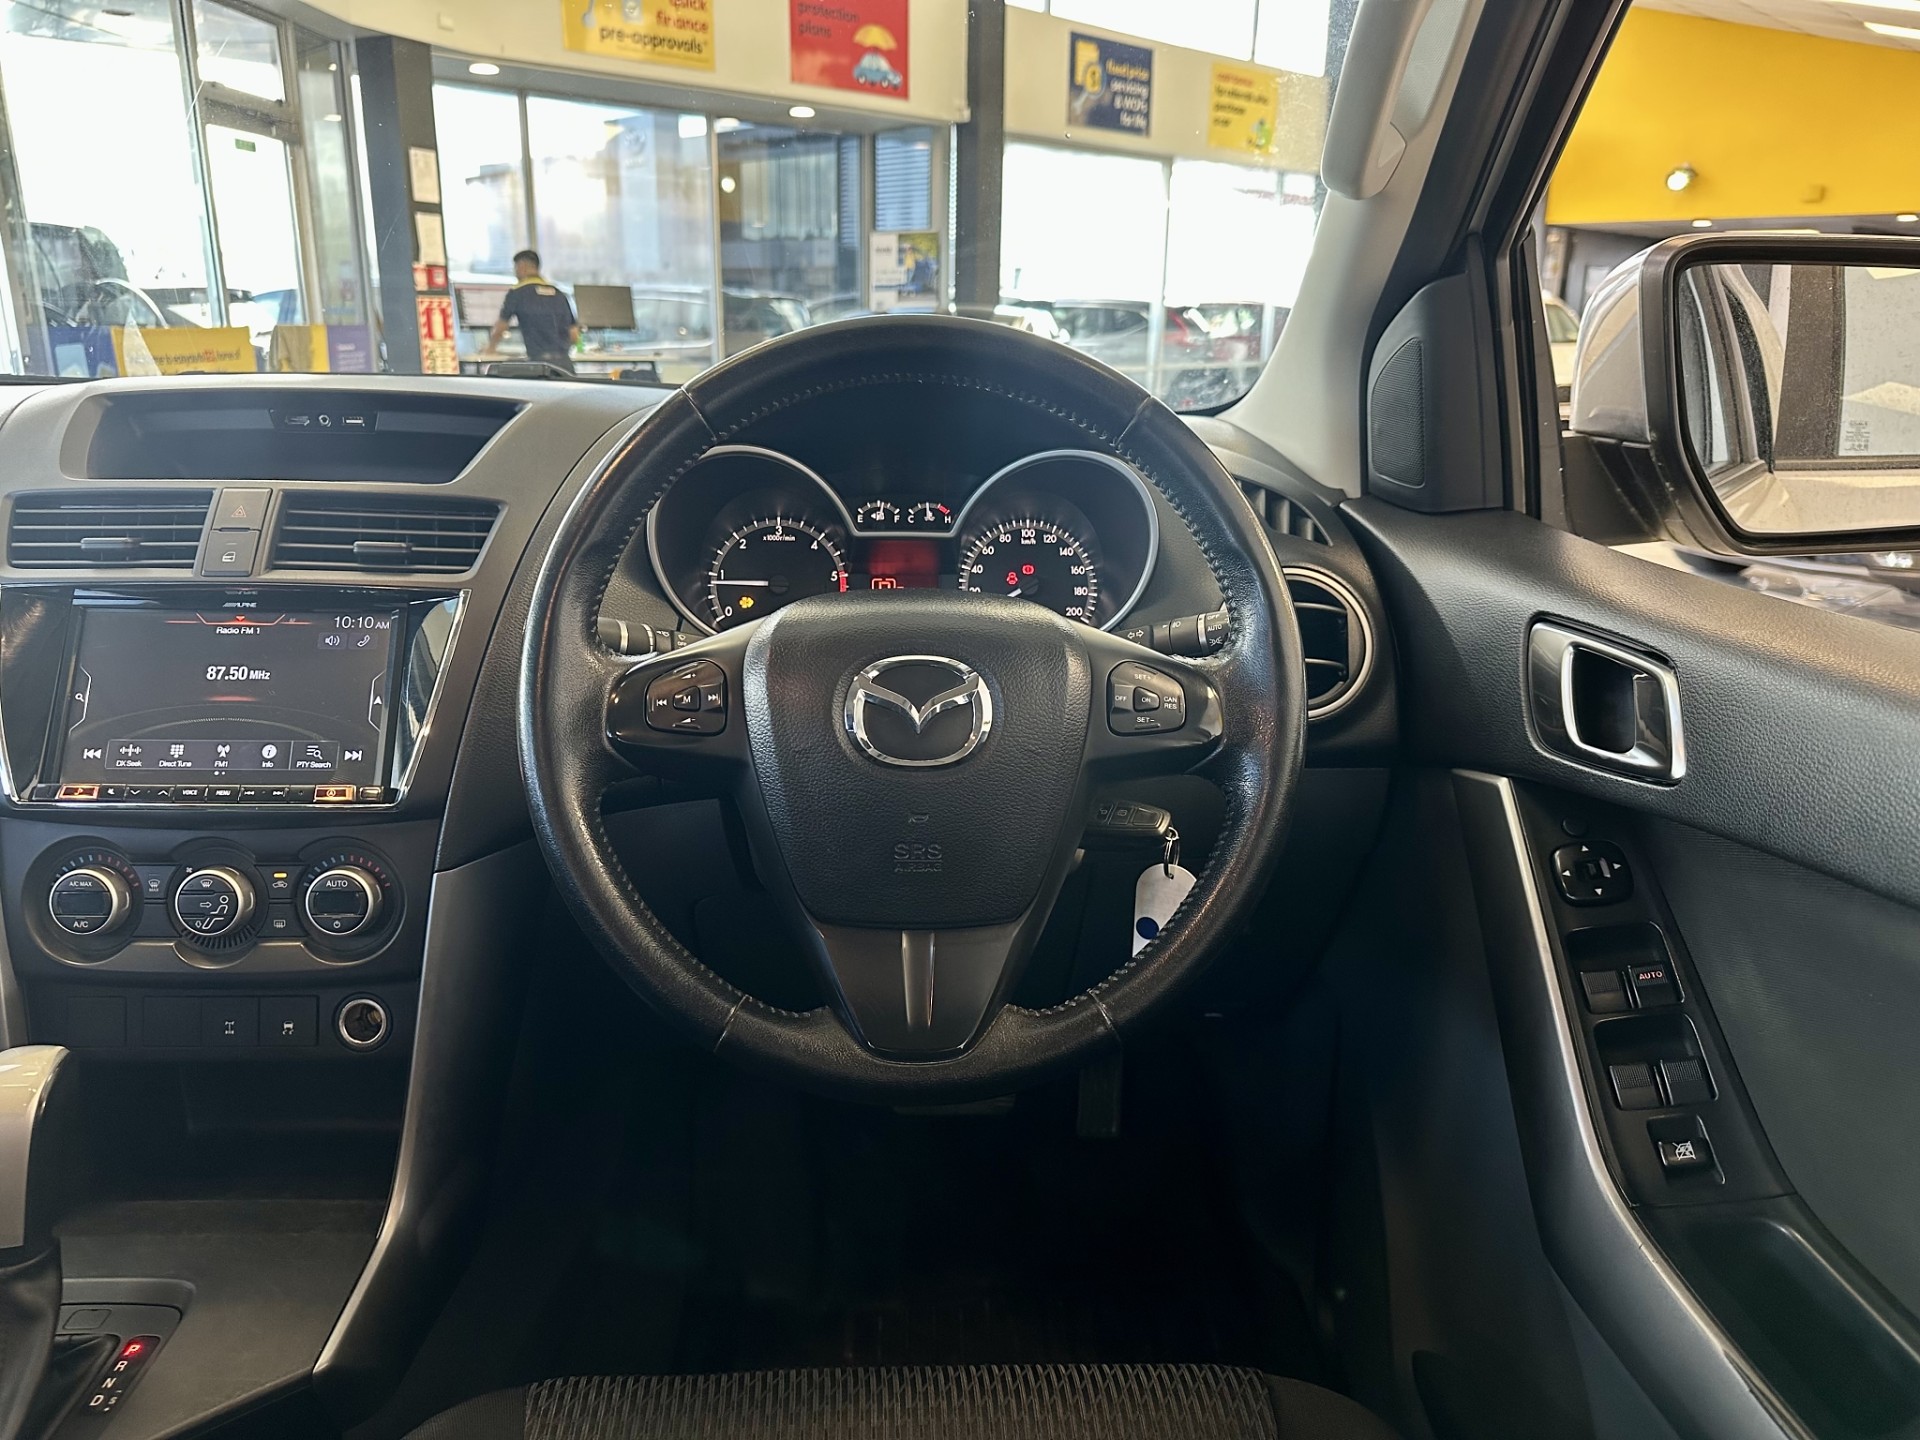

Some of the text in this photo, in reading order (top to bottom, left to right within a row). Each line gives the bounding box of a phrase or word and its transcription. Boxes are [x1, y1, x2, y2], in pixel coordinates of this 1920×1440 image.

[797, 2, 859, 22] protection
[656, 10, 709, 34] finance
[799, 20, 832, 38] plans
[857, 515, 863, 523] E
[894, 515, 900, 523] F
[908, 515, 914, 523] C
[944, 516, 951, 524] H
[775, 525, 782, 536] 3
[1021, 529, 1036, 538] 100
[999, 534, 1011, 543] 80
[1043, 534, 1057, 544] 120
[739, 539, 746, 549] 2
[811, 540, 818, 550] 4
[982, 546, 994, 555] 60
[1059, 547, 1074, 556] 140
[971, 565, 983, 573] 40
[1071, 566, 1085, 575] 160
[720, 570, 724, 580] 1
[830, 571, 838, 581] 5
[1074, 587, 1088, 596] 180
[725, 606, 732, 616] 0
[1066, 607, 1083, 616] 200
[334, 616, 390, 629] 10:10 AM
[216, 627, 260, 635] Radio FM 1
[1207, 624, 1222, 632] AUTO
[206, 666, 271, 680] 87.50 MHz
[214, 760, 228, 768] FM1
[262, 760, 274, 768] Info
[894, 843, 942, 859] SRS
[1639, 970, 1663, 980] AUTO
[123, 1344, 141, 1355] P
[113, 1361, 128, 1371] R
[101, 1378, 117, 1388] N
[89, 1394, 104, 1406] D
